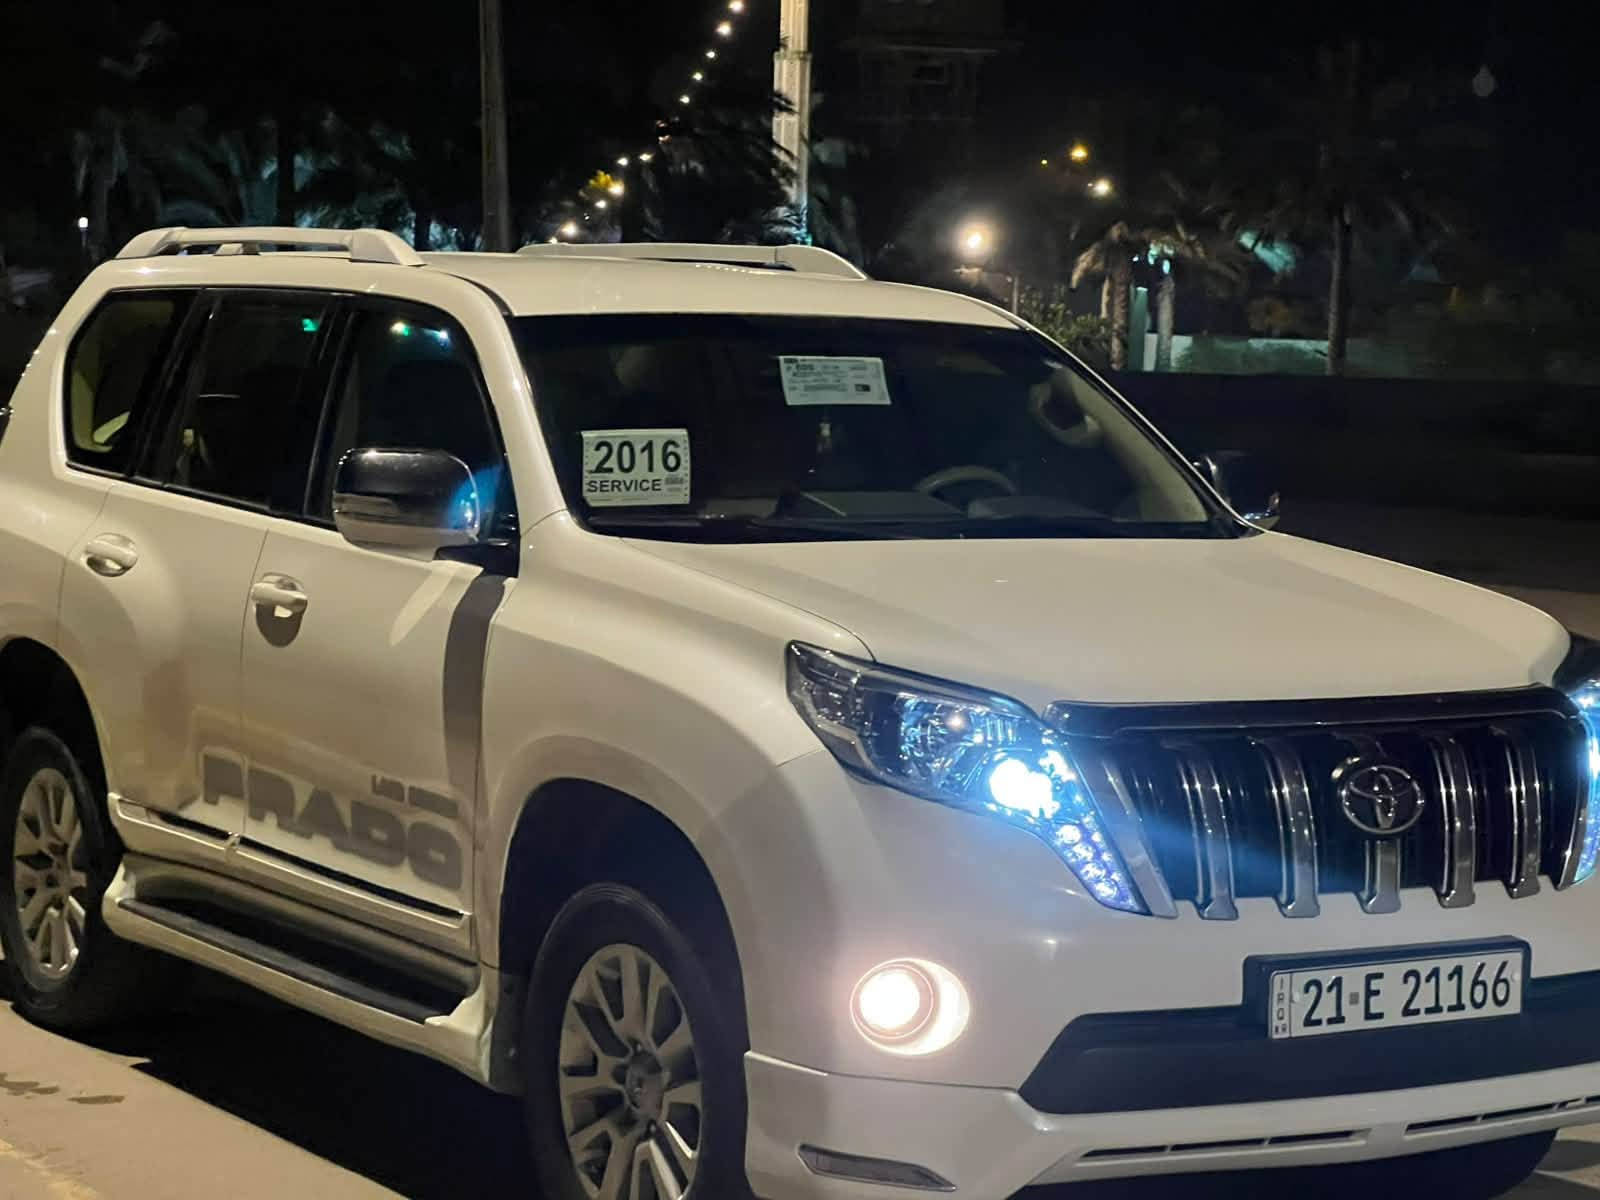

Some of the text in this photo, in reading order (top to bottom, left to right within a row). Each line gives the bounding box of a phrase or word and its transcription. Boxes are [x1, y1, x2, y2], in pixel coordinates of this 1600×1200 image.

[592, 439, 681, 474] 2016
[587, 479, 662, 493] SERVICE
[203, 753, 463, 891] PRADO
[1303, 960, 1511, 1028] 21 E 21166
